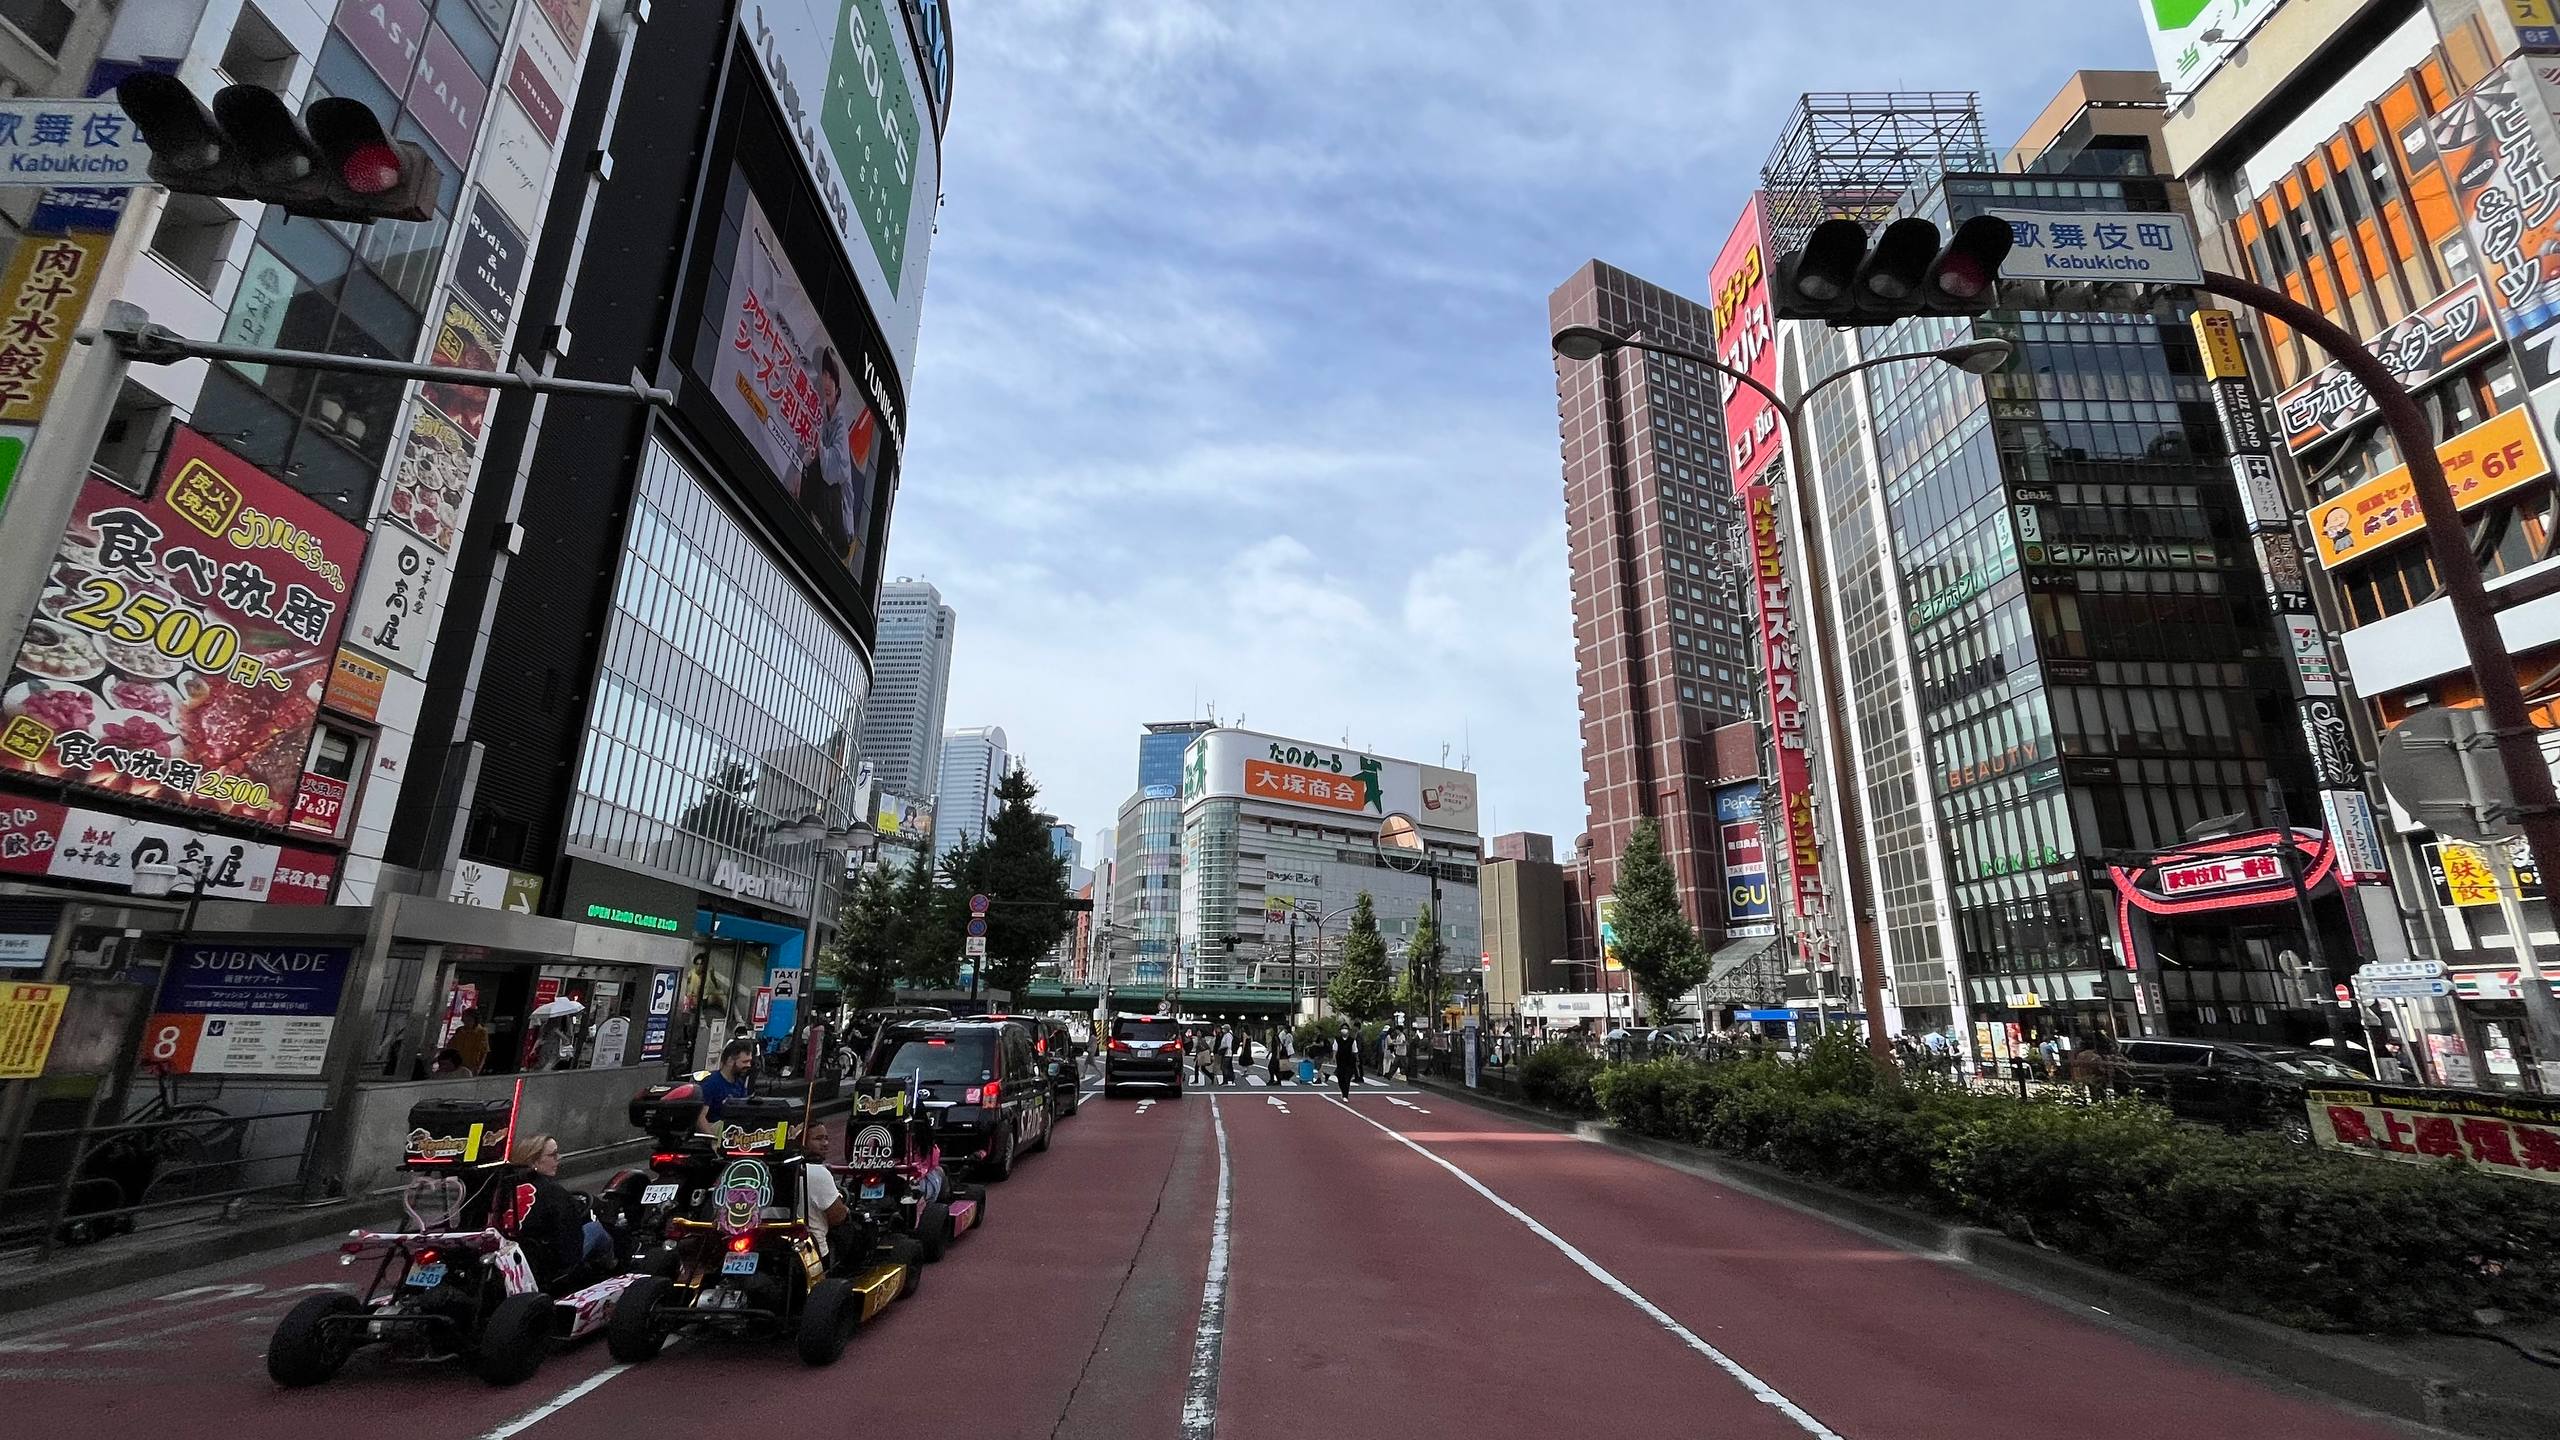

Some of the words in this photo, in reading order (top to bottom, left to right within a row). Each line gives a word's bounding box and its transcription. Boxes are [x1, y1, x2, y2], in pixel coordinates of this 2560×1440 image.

[0, 112, 145, 147] 舞伎
[9, 153, 128, 172] Kabukicho
[838, 74, 900, 236] FLAGSHIP
[860, 165, 897, 262] STORE
[470, 212, 508, 260] Rydia
[2010, 221, 2173, 251] 歌舞伎町
[2044, 253, 2150, 271] Kabukicho
[1714, 244, 1762, 342] パチンコ
[0, 242, 84, 412] 肉汁水餃子
[490, 309, 504, 323] 4F
[2399, 297, 2480, 370] ダーツ
[2233, 383, 2250, 412] BUZZ
[2241, 411, 2261, 448] STAND
[2482, 439, 2524, 478] 6F
[1752, 496, 1781, 578] パチンコ
[1996, 511, 2010, 546] ダーツ
[2018, 507, 2037, 538] ダーツ
[88, 507, 338, 645] 食べ放題
[374, 545, 420, 651] 日高屋
[2282, 592, 2307, 609] 7F
[1762, 583, 1798, 702] エスパス
[55, 730, 202, 794] 食べ放題
[1269, 743, 1343, 774] たのめーる
[1949, 742, 2037, 788] BEAUTY
[1145, 785, 1174, 796] welcia
[1255, 769, 1357, 803] 大塚商会
[2, 831, 56, 858] 飲み
[1788, 790, 1818, 866] パチンコ
[63, 846, 121, 868] 中華食堂
[1729, 866, 1744, 875] TAX
[1745, 864, 1763, 873] FREE
[1981, 845, 2060, 878] POKER
[2166, 855, 2277, 890] 歌舞伎町一番街
[273, 867, 331, 892] 深夜食堂
[714, 858, 766, 898] Alpen
[1732, 884, 1766, 907] GU
[588, 904, 611, 920] OPEN
[634, 914, 657, 929] CLOSE
[190, 951, 329, 975] SUBNADE
[774, 970, 800, 980] TAXI
[652, 979, 666, 1011] P
[153, 1026, 180, 1059] 8
[848, 1156, 896, 1169] Sunshine
[853, 1146, 892, 1158] HELLO
